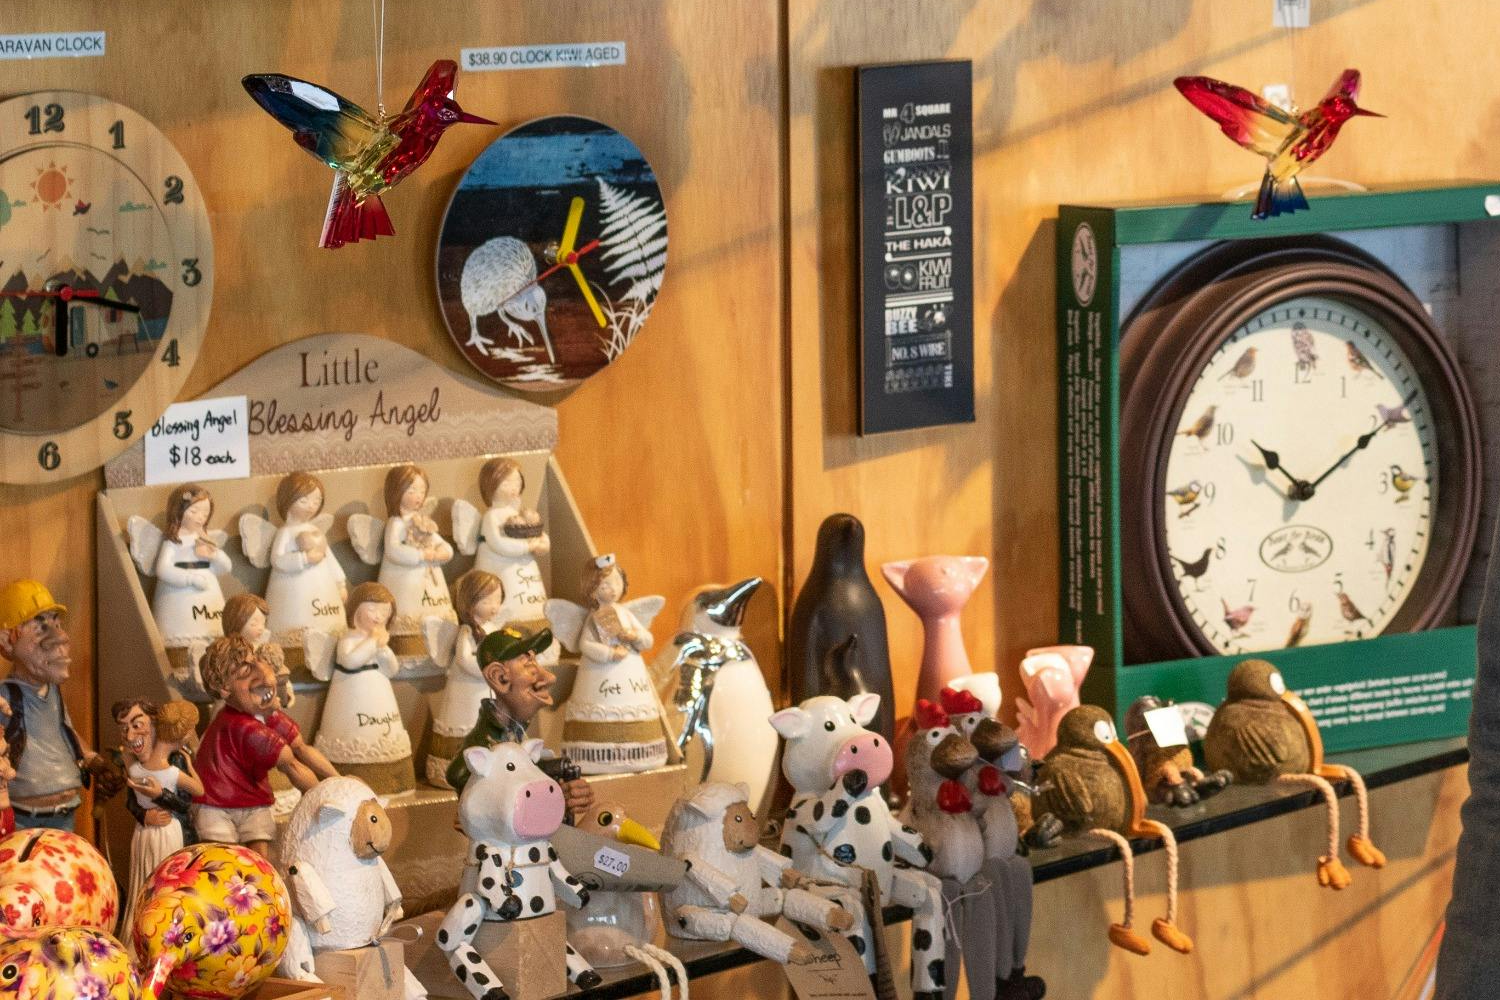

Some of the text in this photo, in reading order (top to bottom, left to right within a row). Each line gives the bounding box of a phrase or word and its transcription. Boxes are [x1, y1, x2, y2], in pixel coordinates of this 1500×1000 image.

[55, 36, 101, 51] CLOCK
[469, 46, 620, 66] $38.90 CLOCK KIWI AGED
[24, 103, 65, 135] 12
[915, 103, 951, 116] SQUARE
[108, 119, 125, 150] 1
[901, 123, 951, 142] JANDALS
[163, 175, 184, 206] 2
[886, 173, 950, 195] KIWI
[896, 193, 953, 230] L&P
[885, 237, 952, 252] THE HAKA
[181, 258, 201, 287] 3
[919, 258, 952, 276] KIWI
[919, 274, 950, 290] FRUIT
[885, 320, 917, 335] BEE
[161, 338, 181, 368] 4
[919, 342, 945, 357] WIRE
[300, 347, 379, 388] Little
[1293, 361, 1311, 383] 12
[1251, 379, 1264, 402] 11
[1341, 376, 1347, 398] 1
[113, 410, 133, 440] 5
[203, 409, 237, 434] Angel
[248, 387, 441, 442] Blessing Angel
[1216, 423, 1233, 445] 10
[38, 441, 60, 471] 6
[169, 446, 236, 468] $18 each
[1204, 483, 1215, 504] 9
[1377, 473, 1388, 494] 3
[1216, 537, 1227, 559] 8
[1365, 528, 1375, 550] 4
[1247, 579, 1257, 601] 7
[1333, 573, 1342, 595] 5
[311, 599, 340, 617] Sister
[1289, 590, 1300, 613] 6
[599, 678, 622, 698] Get
[598, 853, 628, 874] $27.00
